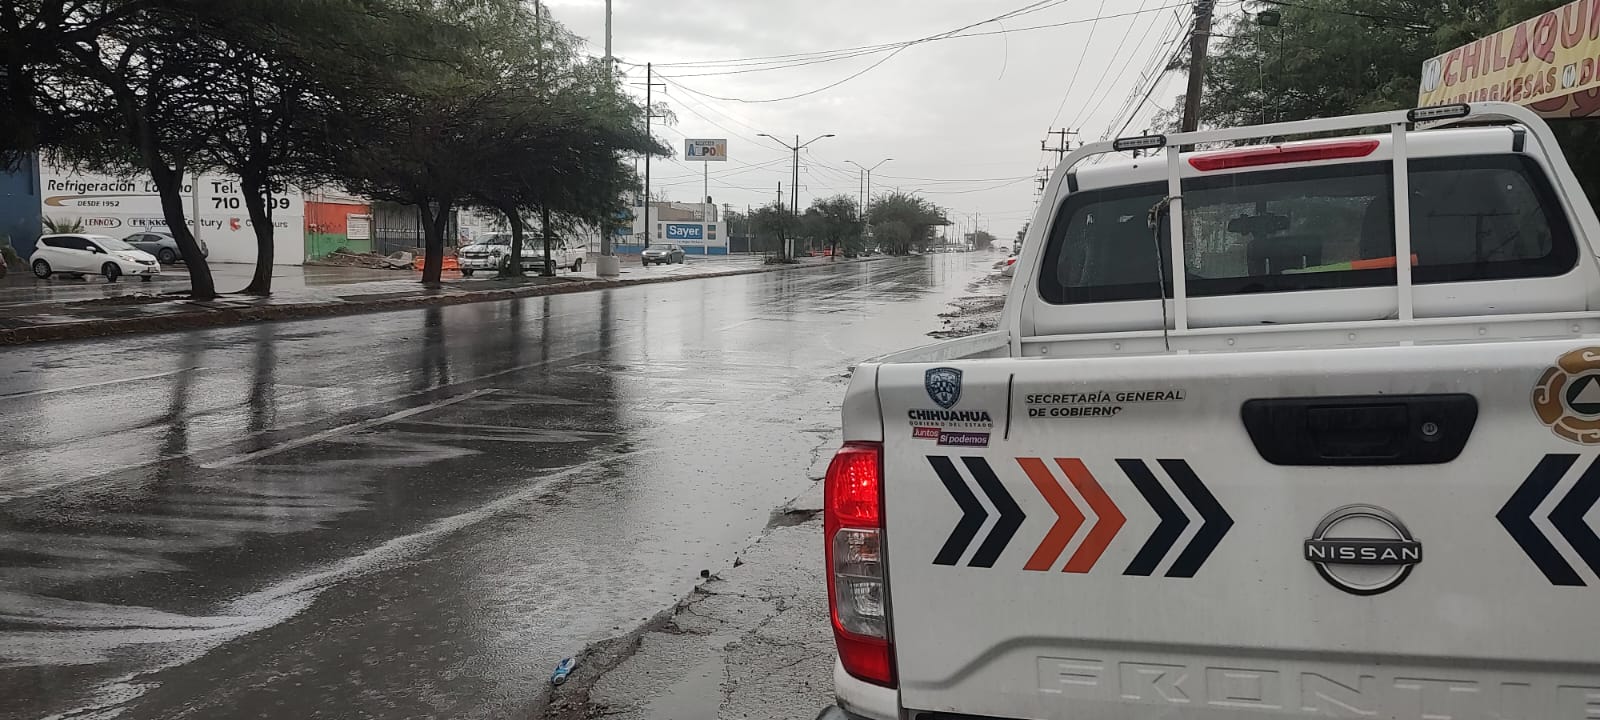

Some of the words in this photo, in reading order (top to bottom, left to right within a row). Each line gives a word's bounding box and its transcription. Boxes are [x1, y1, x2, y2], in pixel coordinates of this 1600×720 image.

[47, 179, 136, 194] Refrigeración
[211, 181, 238, 194] Tel.
[211, 197, 240, 209] 710
[84, 217, 114, 227] LENNOX
[184, 217, 223, 230] etury
[669, 225, 699, 238] Sayer
[1026, 390, 1111, 404] SECRETARÍA
[1115, 390, 1184, 402] GENERAL
[908, 409, 991, 422] CHIHUAHUA
[1028, 407, 1046, 417] DE
[913, 428, 939, 437] Juntos
[940, 434, 948, 443] Sí
[949, 434, 987, 444] podemos
[1307, 544, 1420, 561] NISSAN
